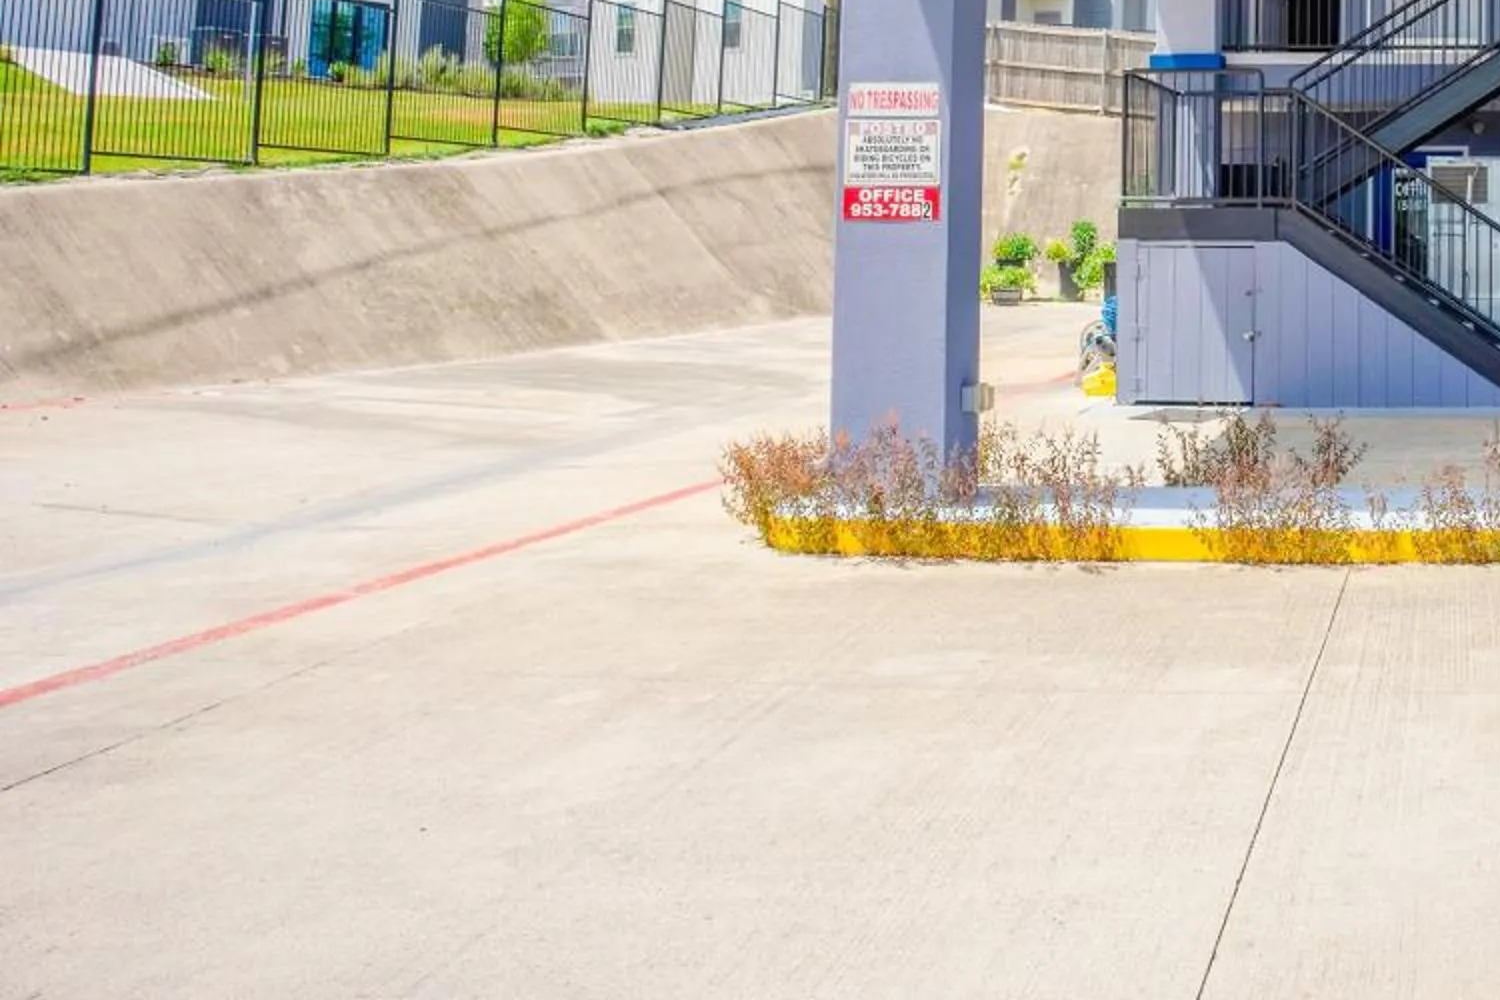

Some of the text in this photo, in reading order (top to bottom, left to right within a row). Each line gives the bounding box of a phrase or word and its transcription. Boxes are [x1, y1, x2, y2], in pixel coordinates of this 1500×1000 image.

[849, 90, 938, 110] NO TRESPASSING
[859, 188, 925, 202] OFFICE
